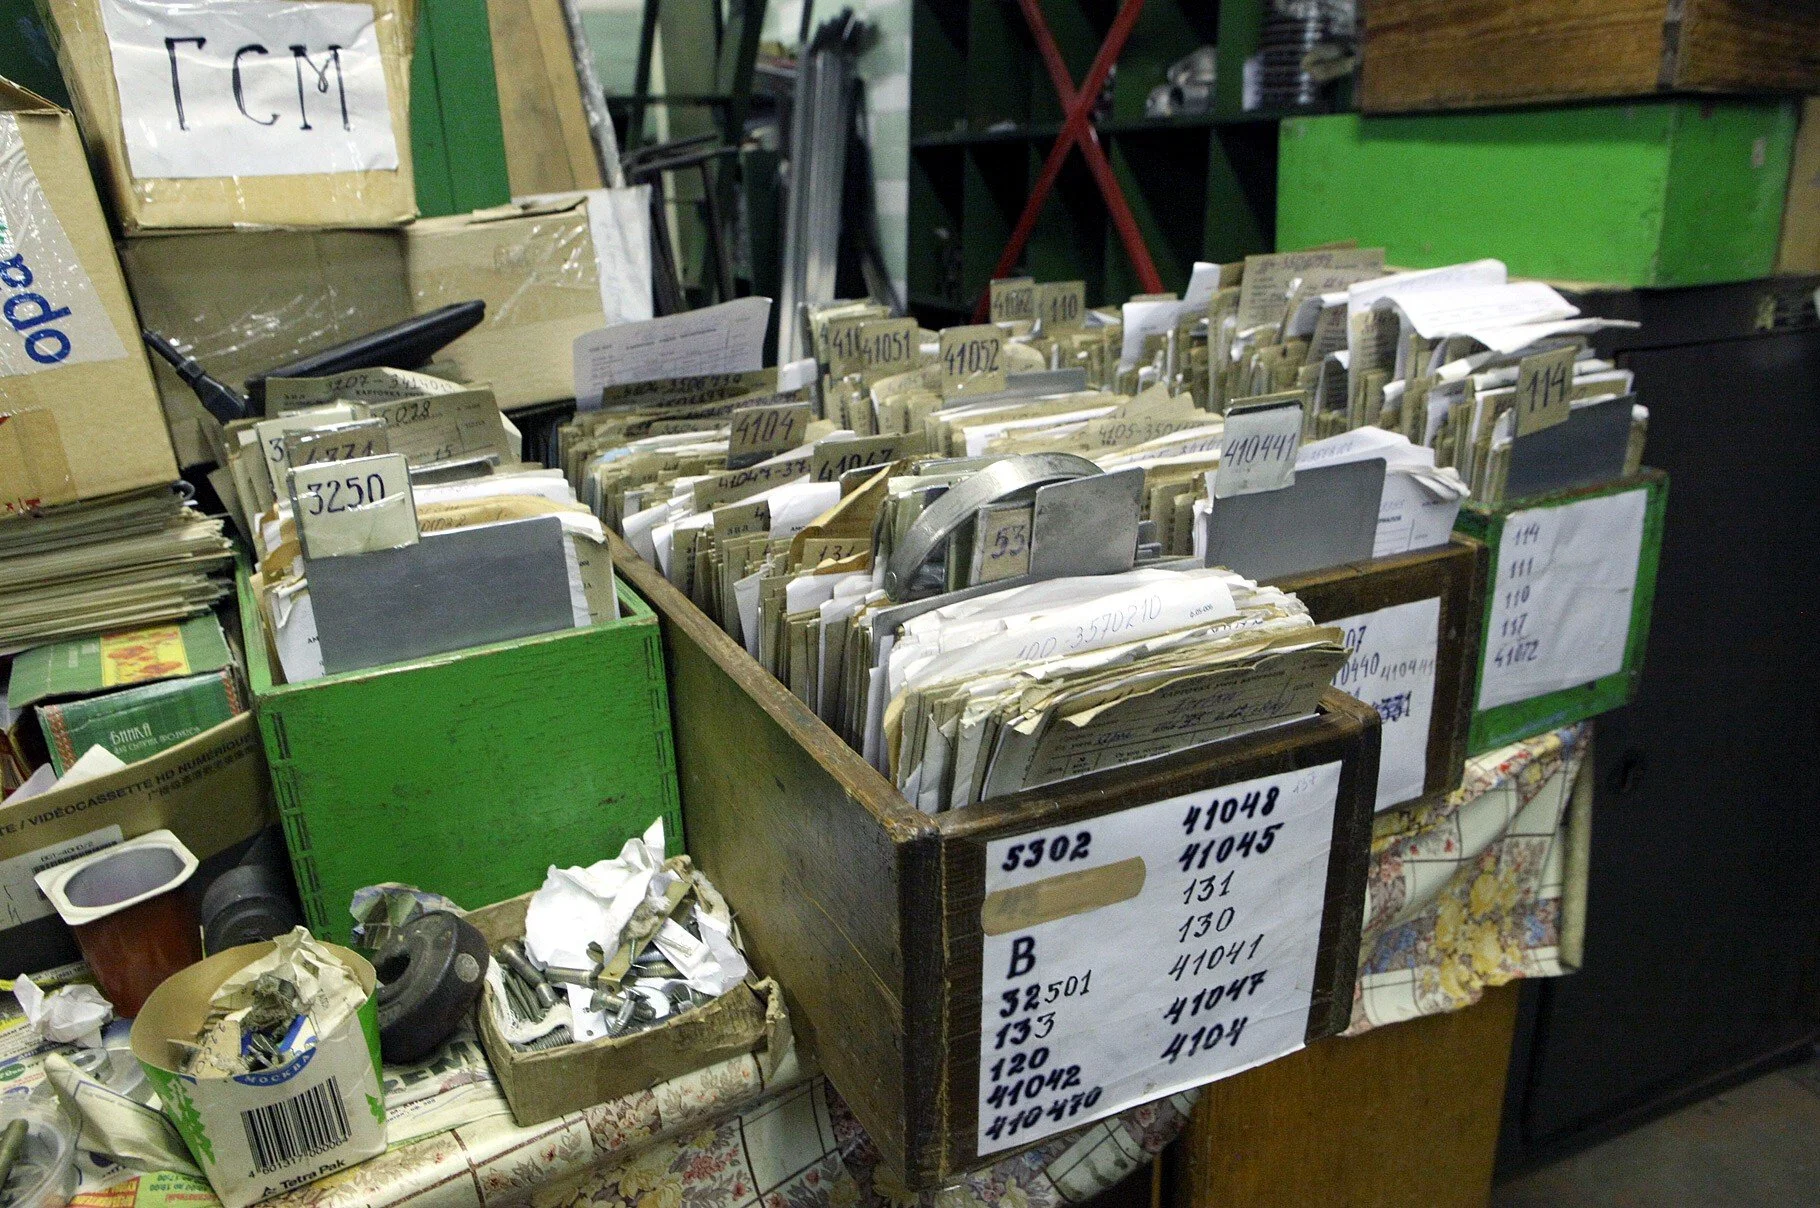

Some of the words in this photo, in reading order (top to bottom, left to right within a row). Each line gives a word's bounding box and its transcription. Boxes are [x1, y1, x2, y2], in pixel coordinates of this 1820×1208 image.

[164, 36, 352, 132] ГСМ
[864, 330, 910, 364] 41051
[943, 337, 999, 377] 41052
[1525, 362, 1567, 414] 114
[735, 410, 794, 450] 4104
[1223, 431, 1297, 468] 410441
[307, 473, 386, 516] 3250
[1181, 785, 1281, 835] 41048
[1001, 830, 1093, 872] 5302
[1178, 822, 1284, 873] 41045
[1183, 870, 1236, 905] 131
[1178, 906, 1236, 943] 130
[1168, 933, 1265, 981] 41041
[1163, 970, 1267, 1026] 41047
[995, 1011, 1056, 1049] 133
[1160, 1016, 1249, 1065] 4104
[990, 1046, 1050, 1082] 120
[986, 1064, 1082, 1109] 41042
[985, 1086, 1103, 1141] 410470
[279, 1167, 318, 1189] Tetra
[319, 1157, 347, 1177] Pak
